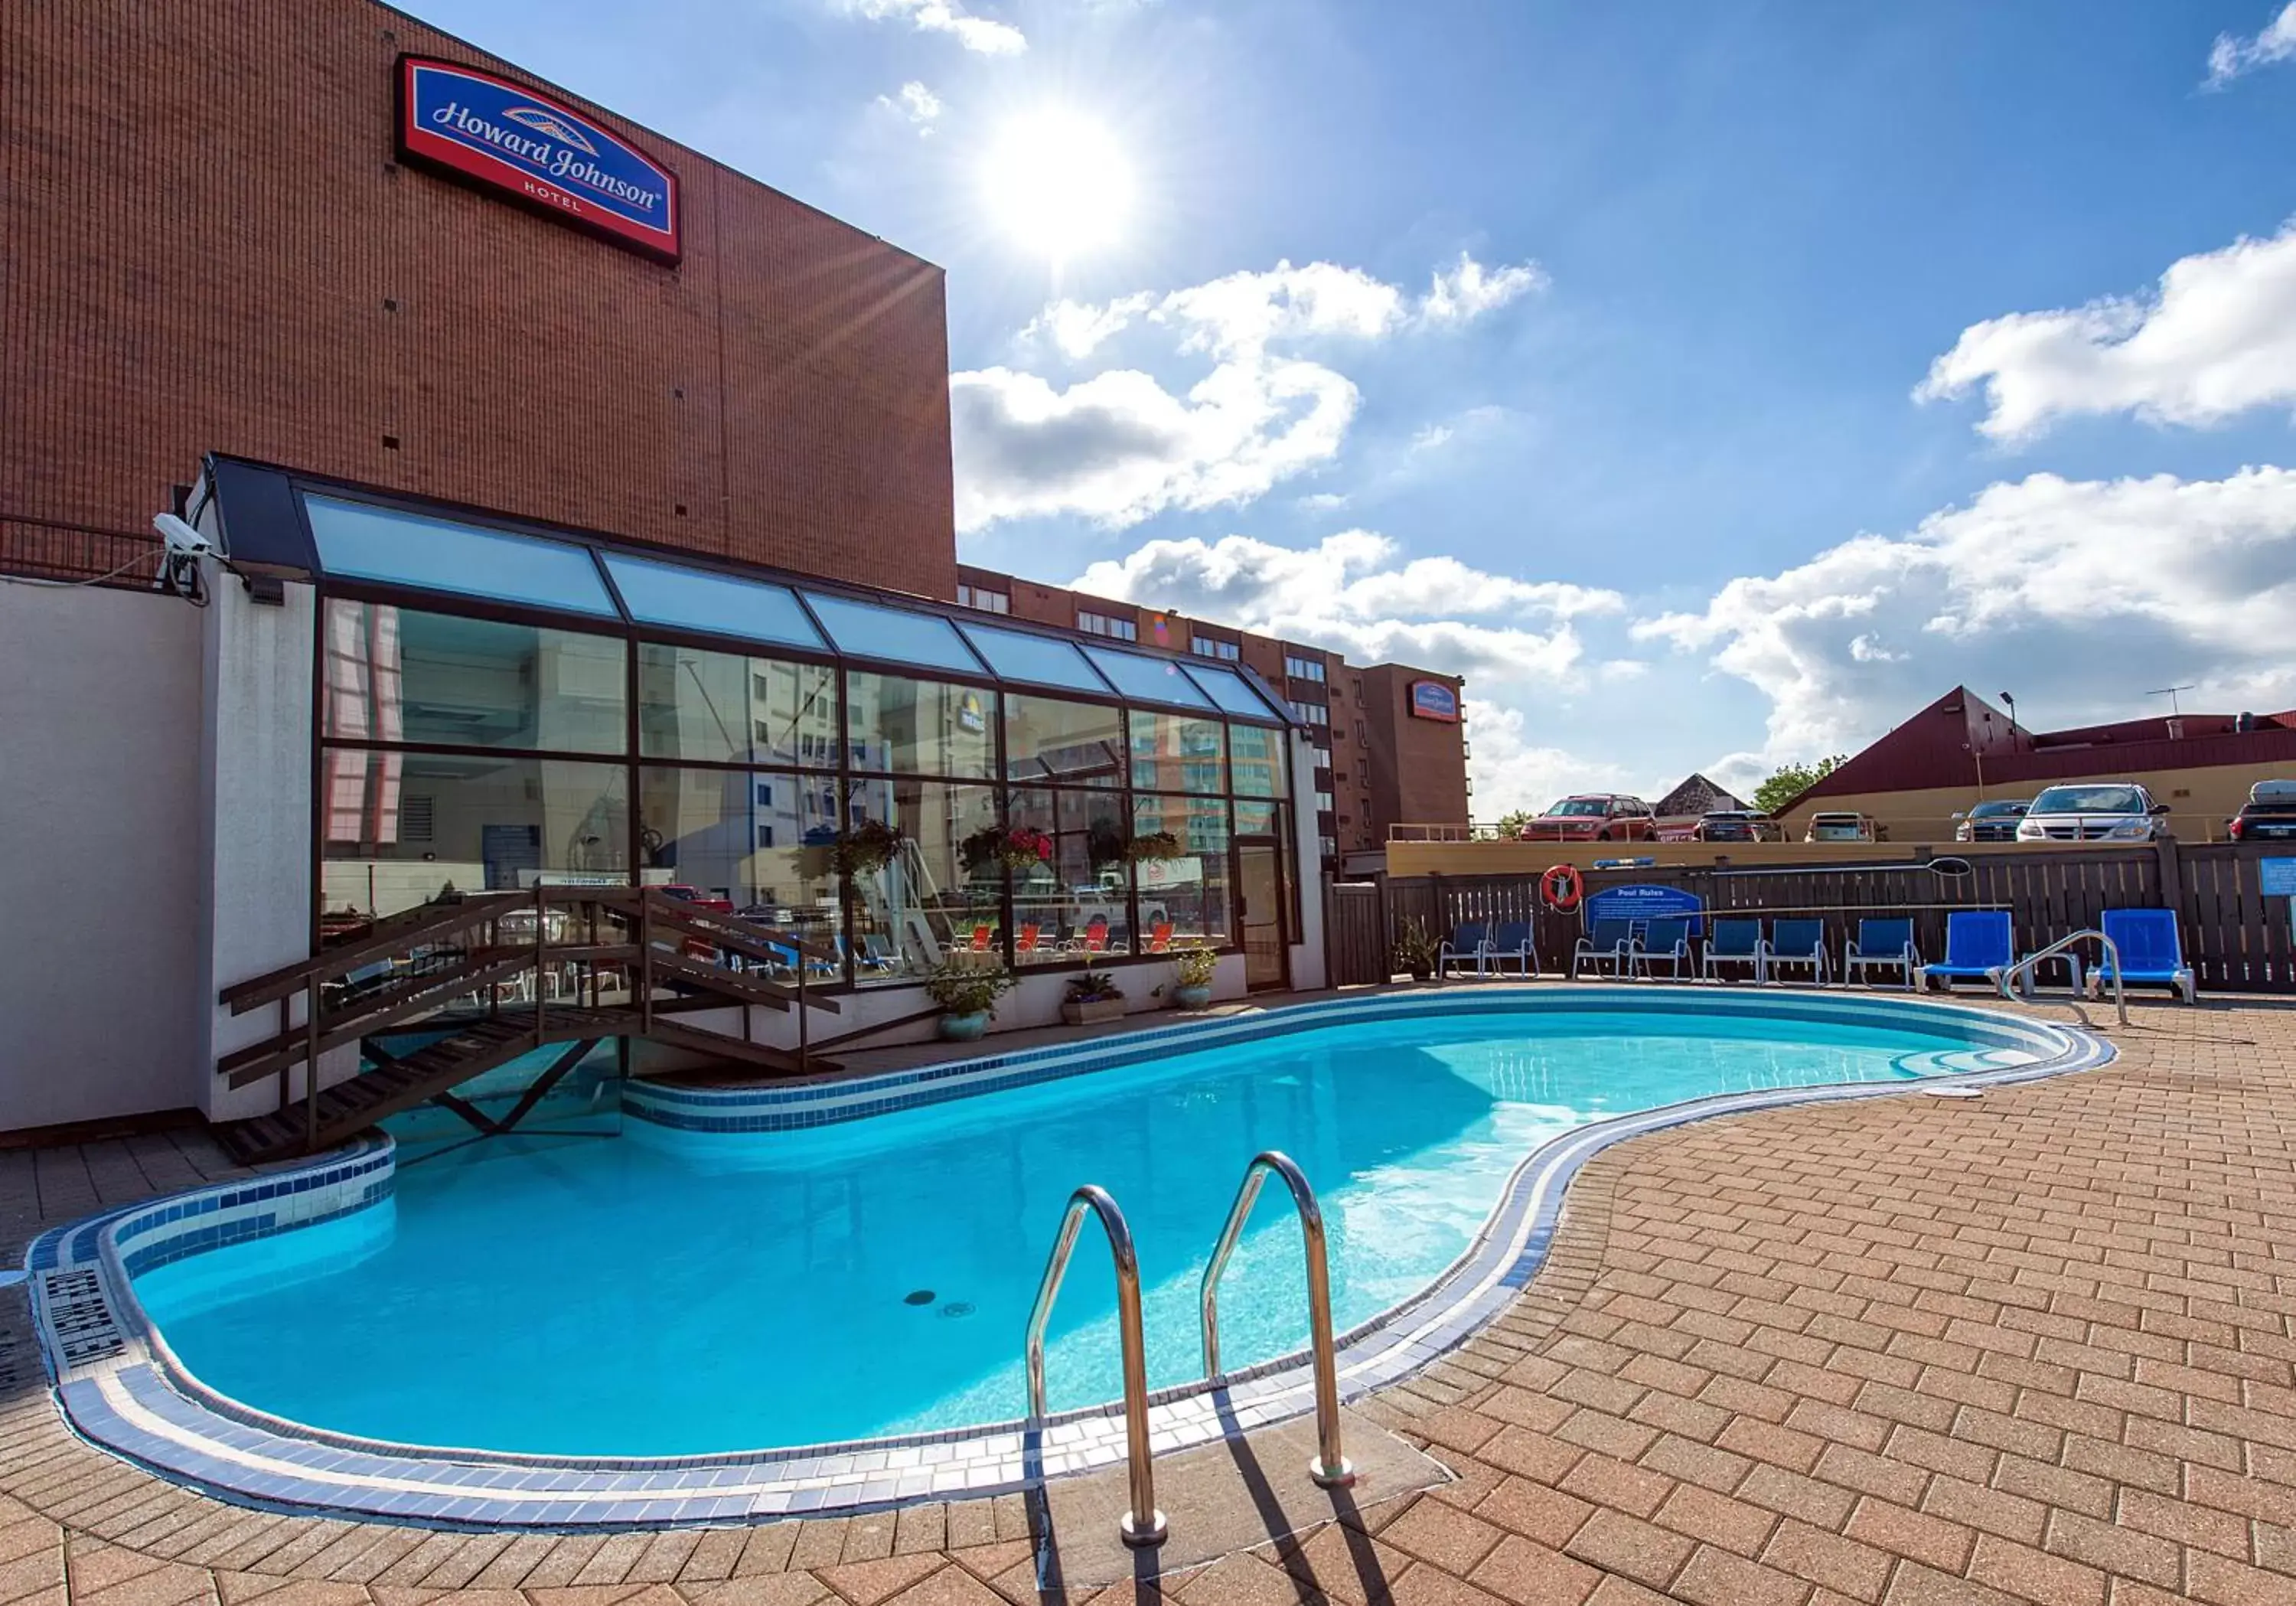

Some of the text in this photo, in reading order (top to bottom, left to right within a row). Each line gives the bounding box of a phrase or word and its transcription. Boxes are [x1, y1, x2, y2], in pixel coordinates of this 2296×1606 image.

[432, 102, 654, 209] Howard Johnson
[524, 180, 582, 212] HOTEL
